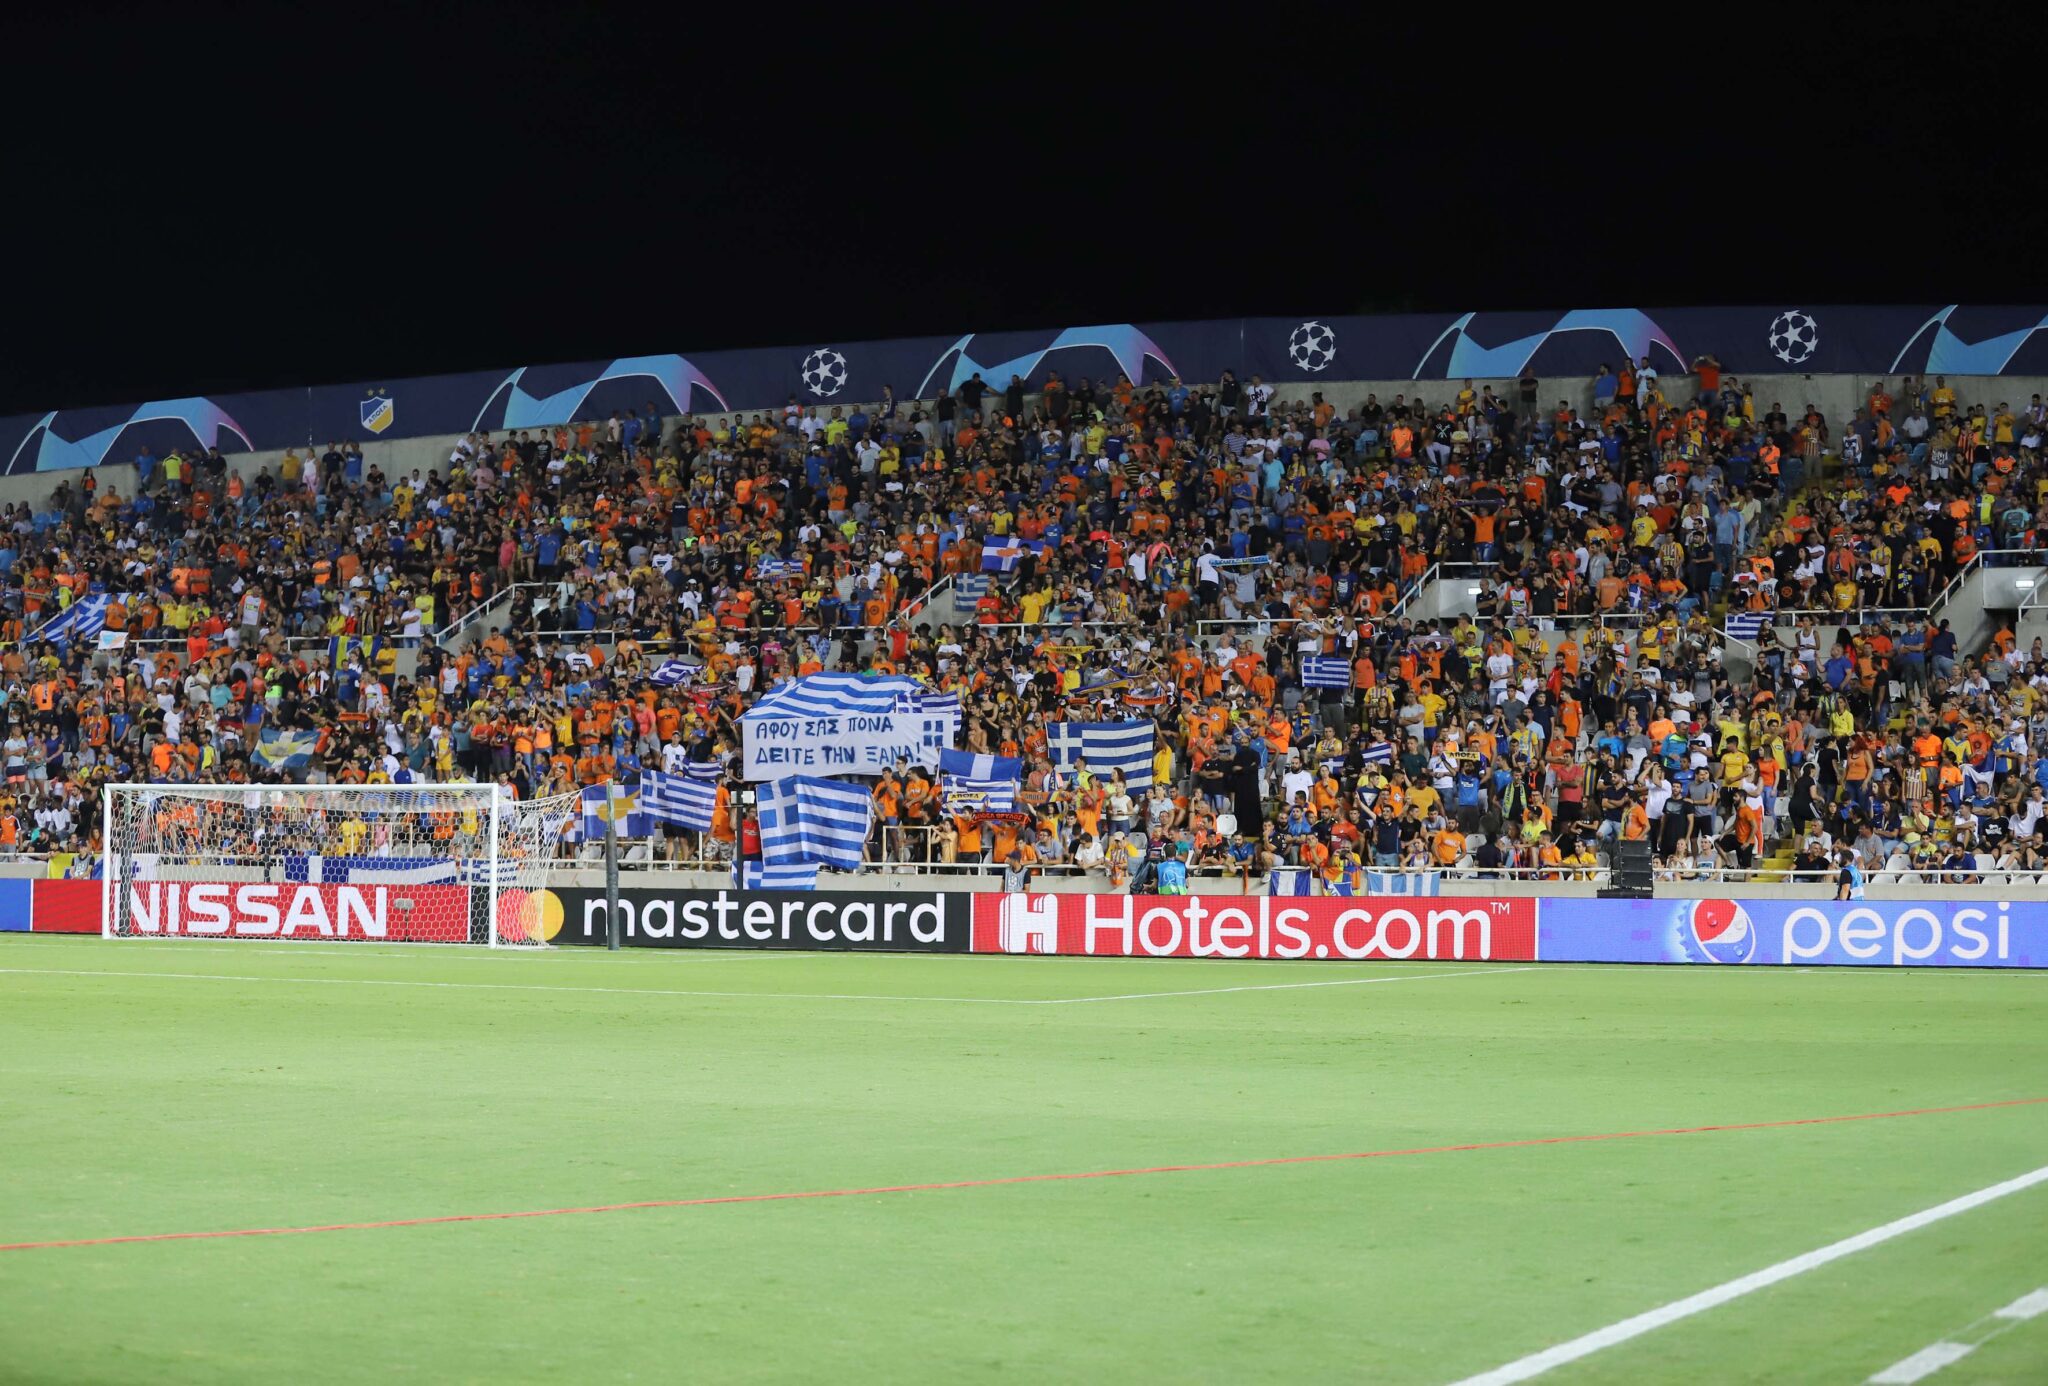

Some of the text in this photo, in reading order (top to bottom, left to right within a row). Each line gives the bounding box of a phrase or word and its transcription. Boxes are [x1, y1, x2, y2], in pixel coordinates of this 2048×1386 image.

[755, 741, 921, 766] ΔΕΙΤΕ ΤΗΝ ΞΑΝΑ!
[756, 716, 893, 740] ΑΦΟΥ ΣΑΣ ΠΟΝΑ
[114, 883, 387, 937] NISSAN
[583, 891, 945, 943] mastercard
[1085, 894, 1510, 960] Hotels.com TM
[1783, 902, 2010, 965] pepsi
